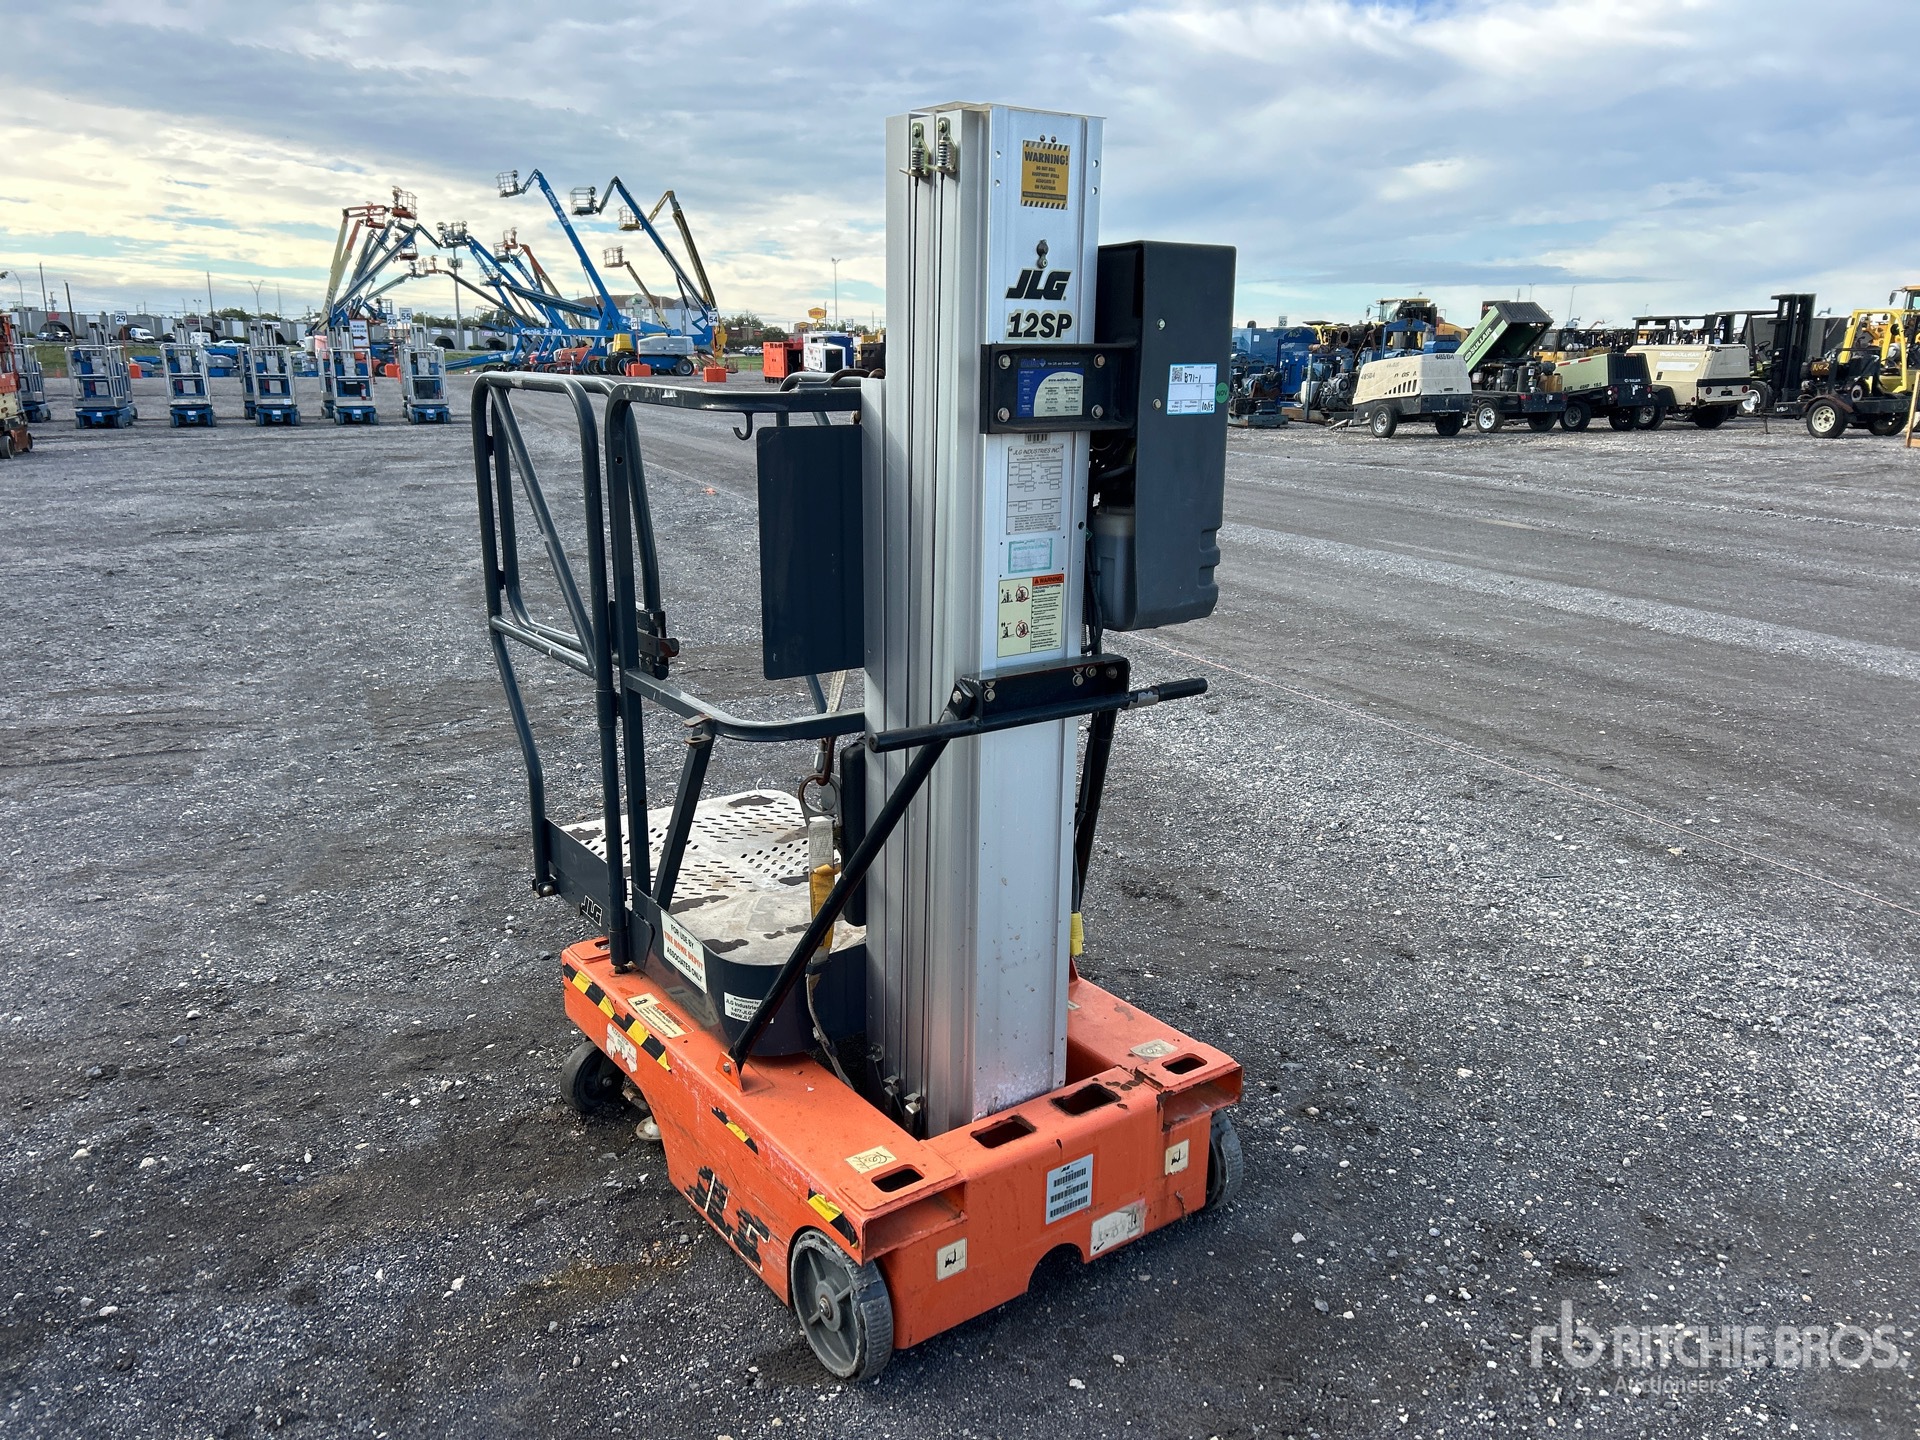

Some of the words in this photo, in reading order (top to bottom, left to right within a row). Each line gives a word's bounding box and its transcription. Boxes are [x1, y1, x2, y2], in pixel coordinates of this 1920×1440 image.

[1025, 151, 1069, 166] WARNING!
[1006, 269, 1071, 300] JLG
[1007, 312, 1073, 338] 12SP
[1470, 327, 1493, 354] SULLAIR
[1216, 389, 1228, 397] NOV
[581, 894, 602, 927] JLG
[670, 924, 680, 936] FOR
[680, 929, 688, 942] USE
[688, 938, 695, 949] BY
[664, 930, 673, 943] THE
[673, 936, 688, 957] HOME
[687, 948, 704, 971] DEPOT
[666, 946, 691, 972] ASSOCIATES
[691, 965, 703, 982] ONLY
